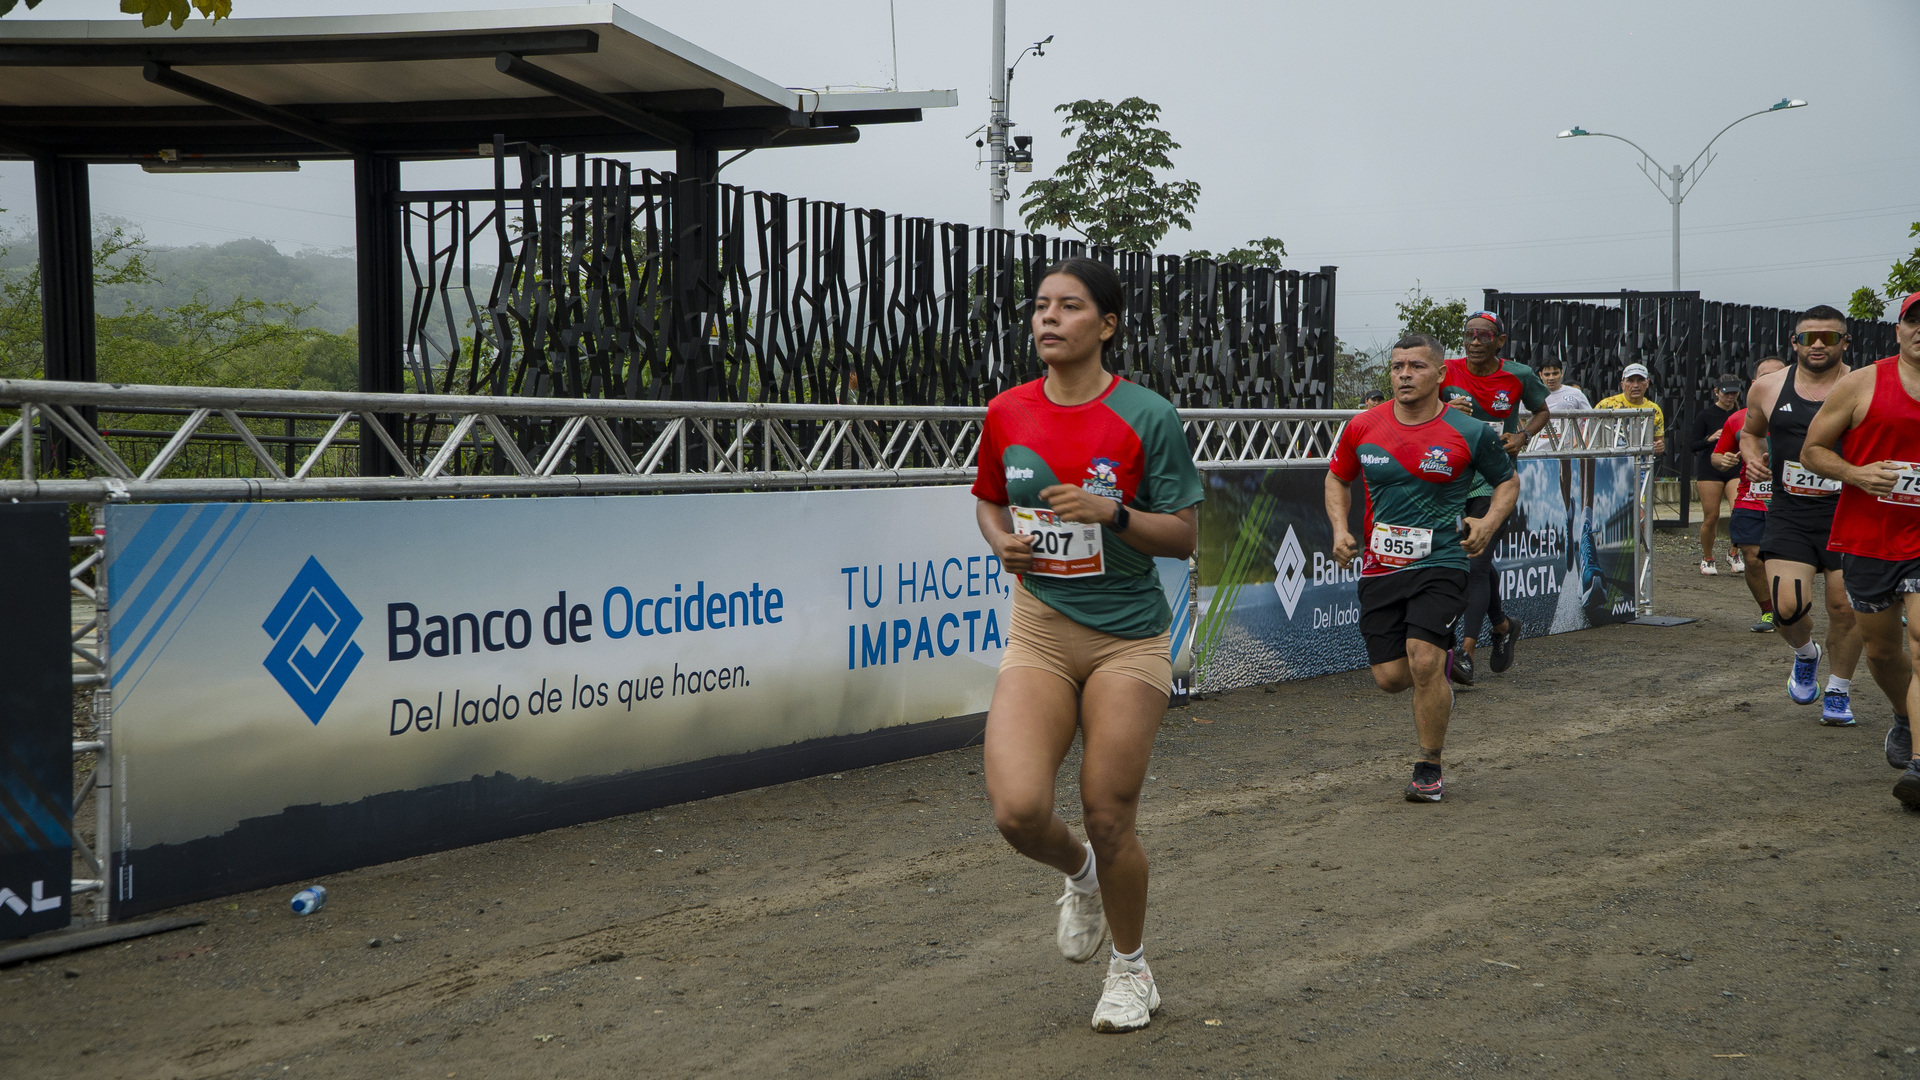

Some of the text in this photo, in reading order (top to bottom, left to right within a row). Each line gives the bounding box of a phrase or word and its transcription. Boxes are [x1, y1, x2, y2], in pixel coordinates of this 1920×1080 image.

[1796, 473, 1826, 488] 217
[1031, 530, 1073, 556] 207
[1384, 538, 1414, 556] 955
[1493, 529, 1560, 563] U HACER,
[841, 554, 1010, 610] TU HACER,
[1498, 565, 1561, 601] MPACTA.
[387, 580, 784, 662] Banco de Occidente
[1313, 602, 1360, 630] Del lado
[1611, 600, 1636, 616] AVAL
[389, 663, 751, 736] Del lado de los que hacen.
